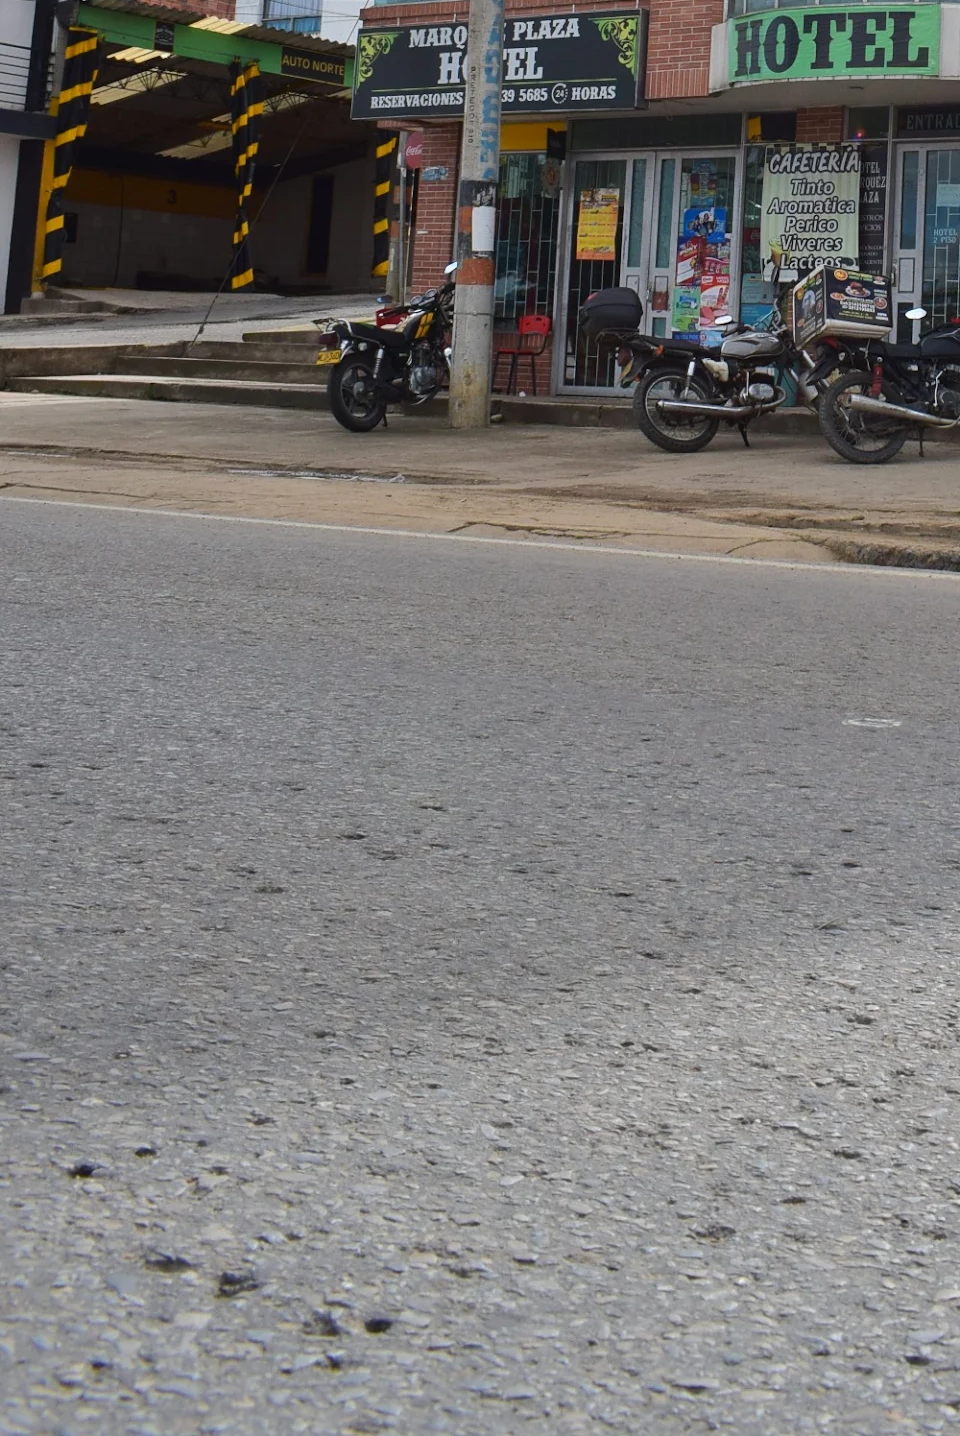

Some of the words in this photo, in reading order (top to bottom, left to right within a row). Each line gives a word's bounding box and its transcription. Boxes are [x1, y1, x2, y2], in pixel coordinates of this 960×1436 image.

[408, 17, 507, 48] MARQ
[513, 17, 581, 42] PLAZA
[734, 11, 929, 77] HOTEL
[282, 54, 311, 70] AUTO
[312, 60, 345, 76] NORTE
[437, 45, 544, 84] HEL
[370, 91, 464, 110] RESERVACIONES
[518, 86, 549, 103] 5685
[571, 85, 617, 101] HORAS
[769, 145, 860, 174] CAFETERÍA
[790, 177, 836, 196] Tinto
[767, 196, 856, 214] Aromatica
[784, 215, 839, 233] Perico
[780, 235, 843, 252] Viveres
[780, 254, 842, 271] Lacteos
